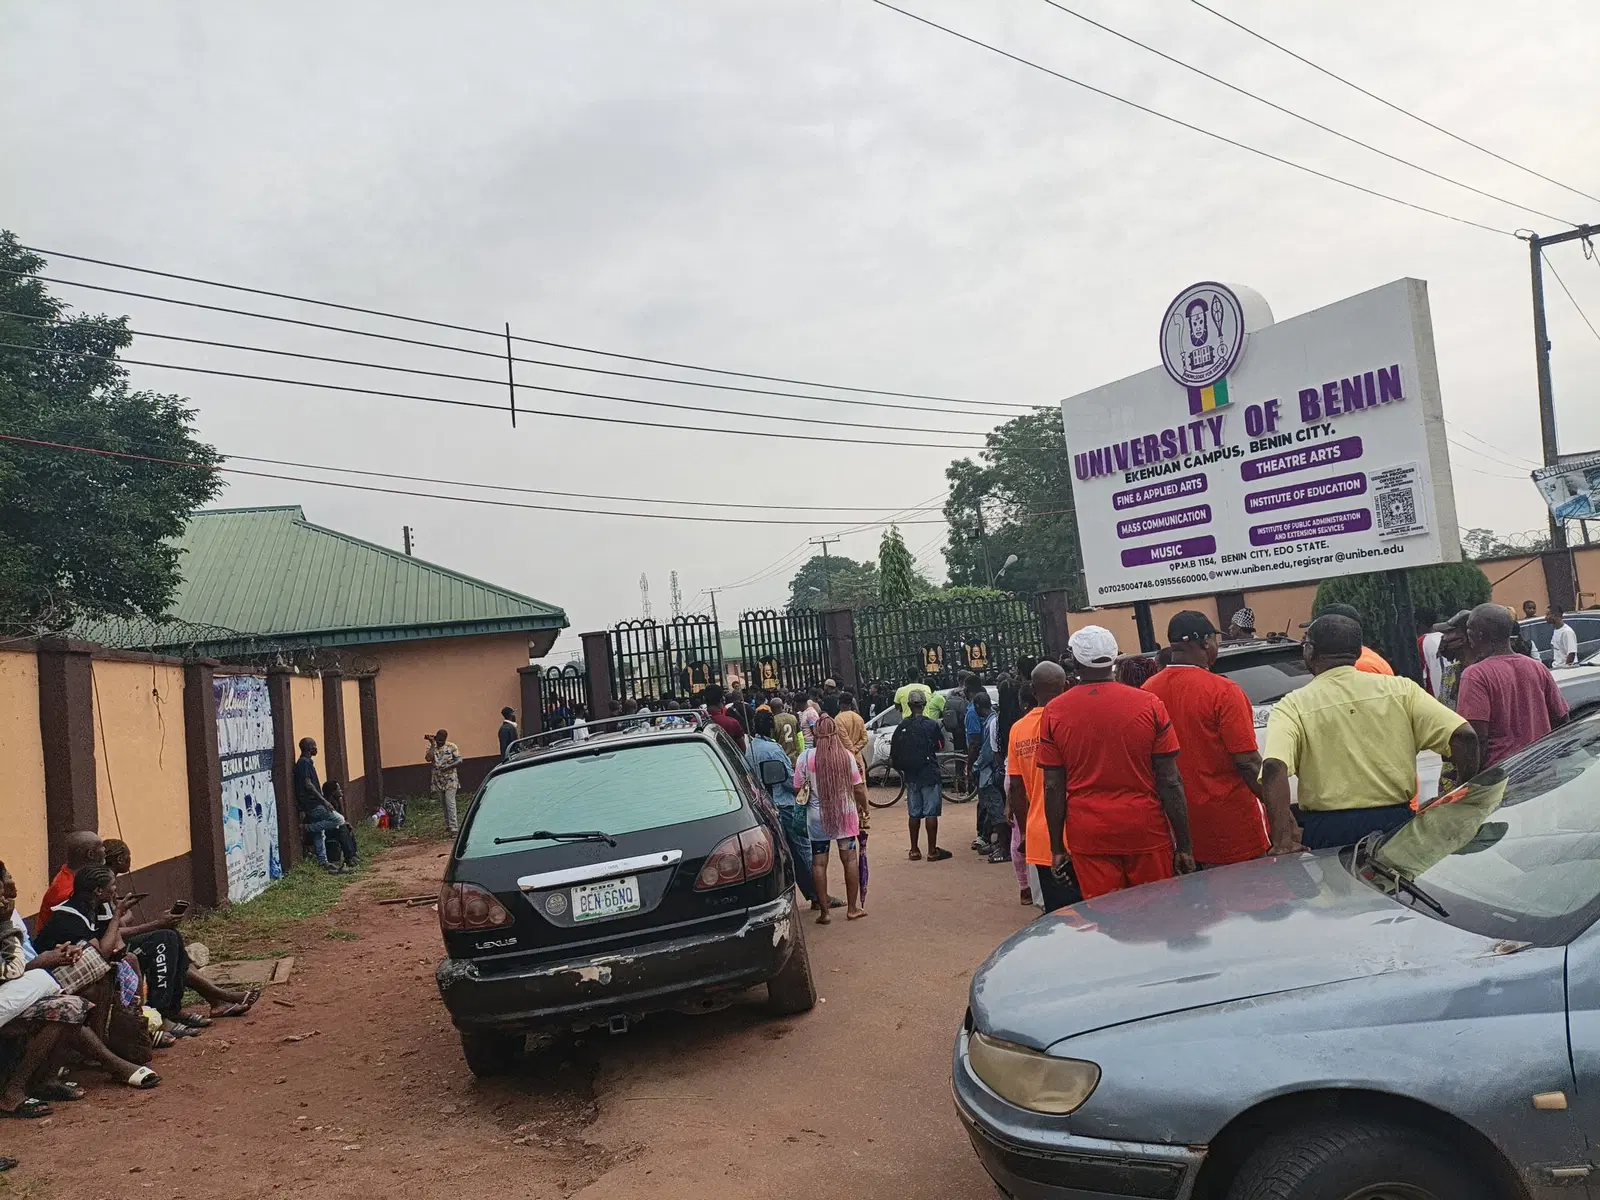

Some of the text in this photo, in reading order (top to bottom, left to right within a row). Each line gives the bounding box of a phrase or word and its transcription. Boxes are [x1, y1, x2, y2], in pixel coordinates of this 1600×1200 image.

[1074, 364, 1403, 481] UNIVERSITY OF BENIN
[1125, 422, 1336, 484] EKEHUAN CAMPUS, BENIN CITY.
[1256, 445, 1341, 474] THEATRE ARTS
[1116, 478, 1202, 506] FINE & APPLIED ARTS
[1249, 492, 1292, 508] INSTITUTE
[1293, 489, 1305, 500] OF
[1307, 479, 1360, 498] EDUCATION
[1121, 509, 1207, 535] MASS COMMUNICATION
[1257, 512, 1361, 535] INSTITUTE OF PUBLIC ADMINISTRATION
[1274, 524, 1345, 541] AND EXTENSION SERVICES
[1150, 544, 1183, 560] MUSIC
[1198, 557, 1217, 567] 1154,
[1221, 552, 1247, 564] BENIN
[1250, 549, 1271, 559] CITY,
[1273, 545, 1294, 556] EDO
[1296, 540, 1330, 553] STATE.
[783, 723, 793, 743] 2
[590, 883, 615, 891] EDO
[475, 937, 518, 950] LEXUS
